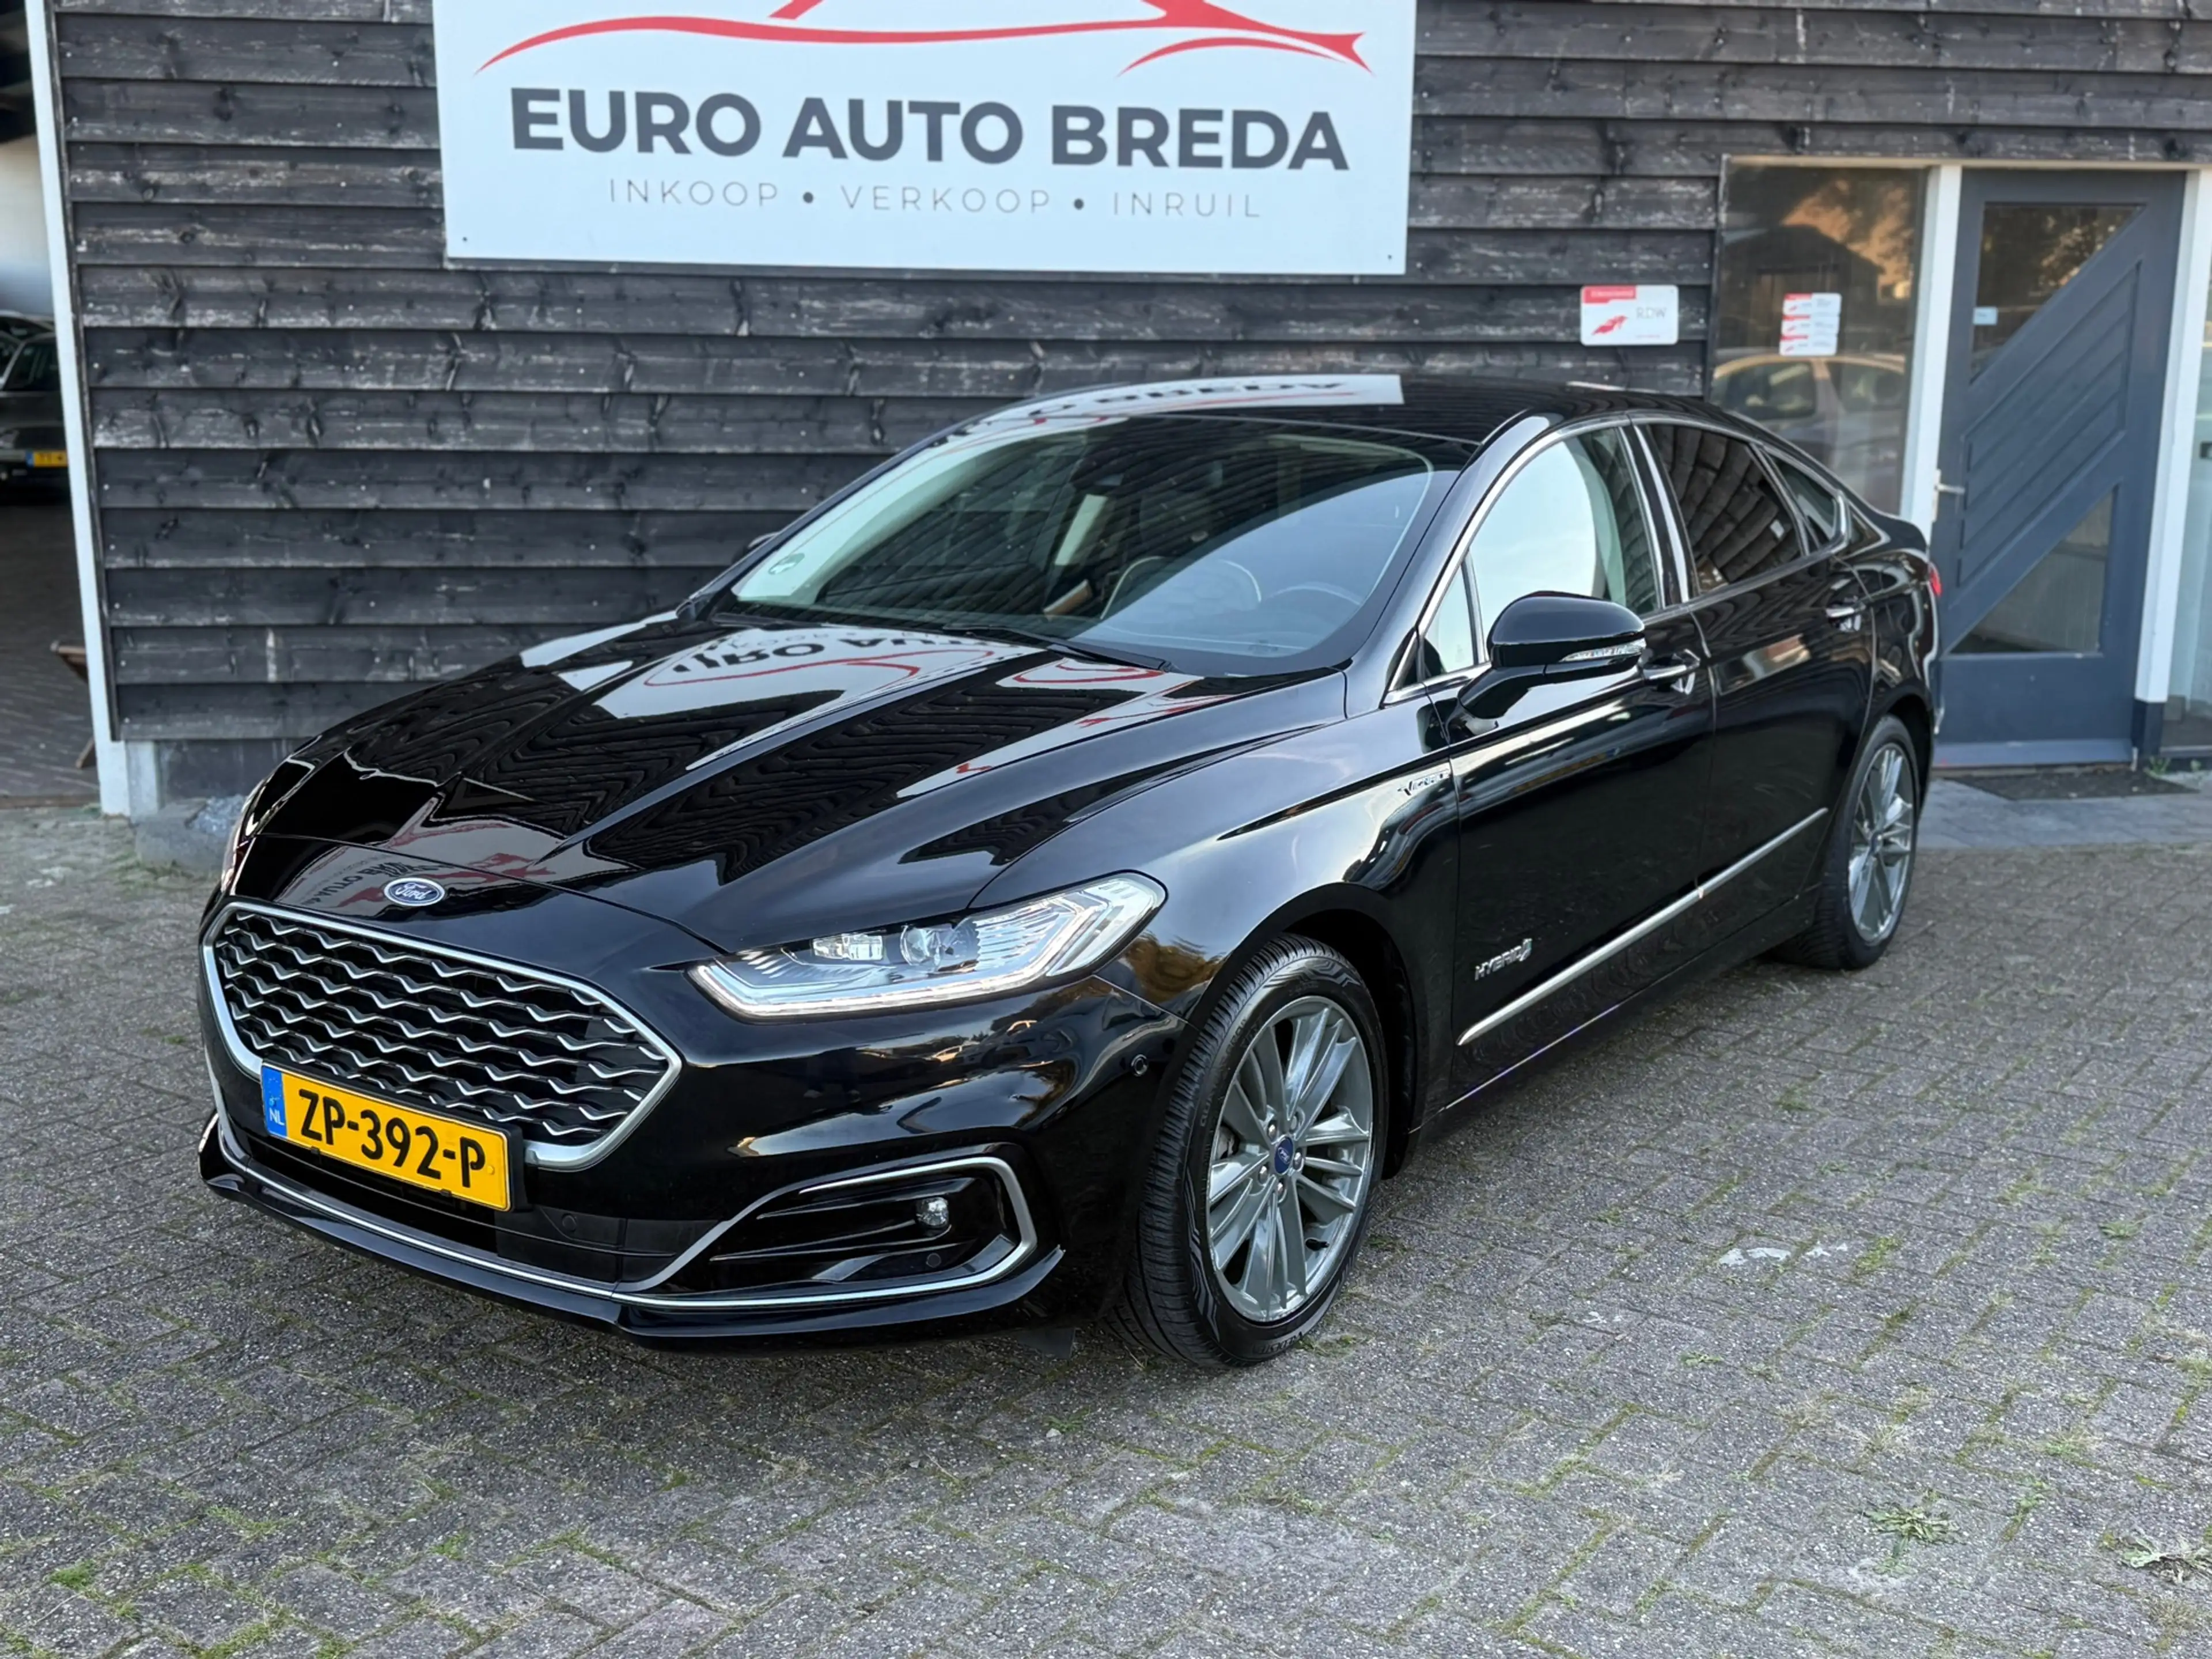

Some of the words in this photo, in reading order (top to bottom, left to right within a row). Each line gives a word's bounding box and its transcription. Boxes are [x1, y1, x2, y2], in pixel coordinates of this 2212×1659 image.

[512, 88, 761, 157] EURO
[782, 97, 1023, 164] AUTO
[1052, 105, 1349, 171] BREDA
[611, 179, 777, 206] INKOOP
[841, 185, 1049, 213] VERKOOP
[1114, 193, 1260, 218] INRUIL
[395, 882, 431, 900] Ford
[269, 1107, 285, 1126] NL
[298, 1088, 486, 1188] ZP-392-P
